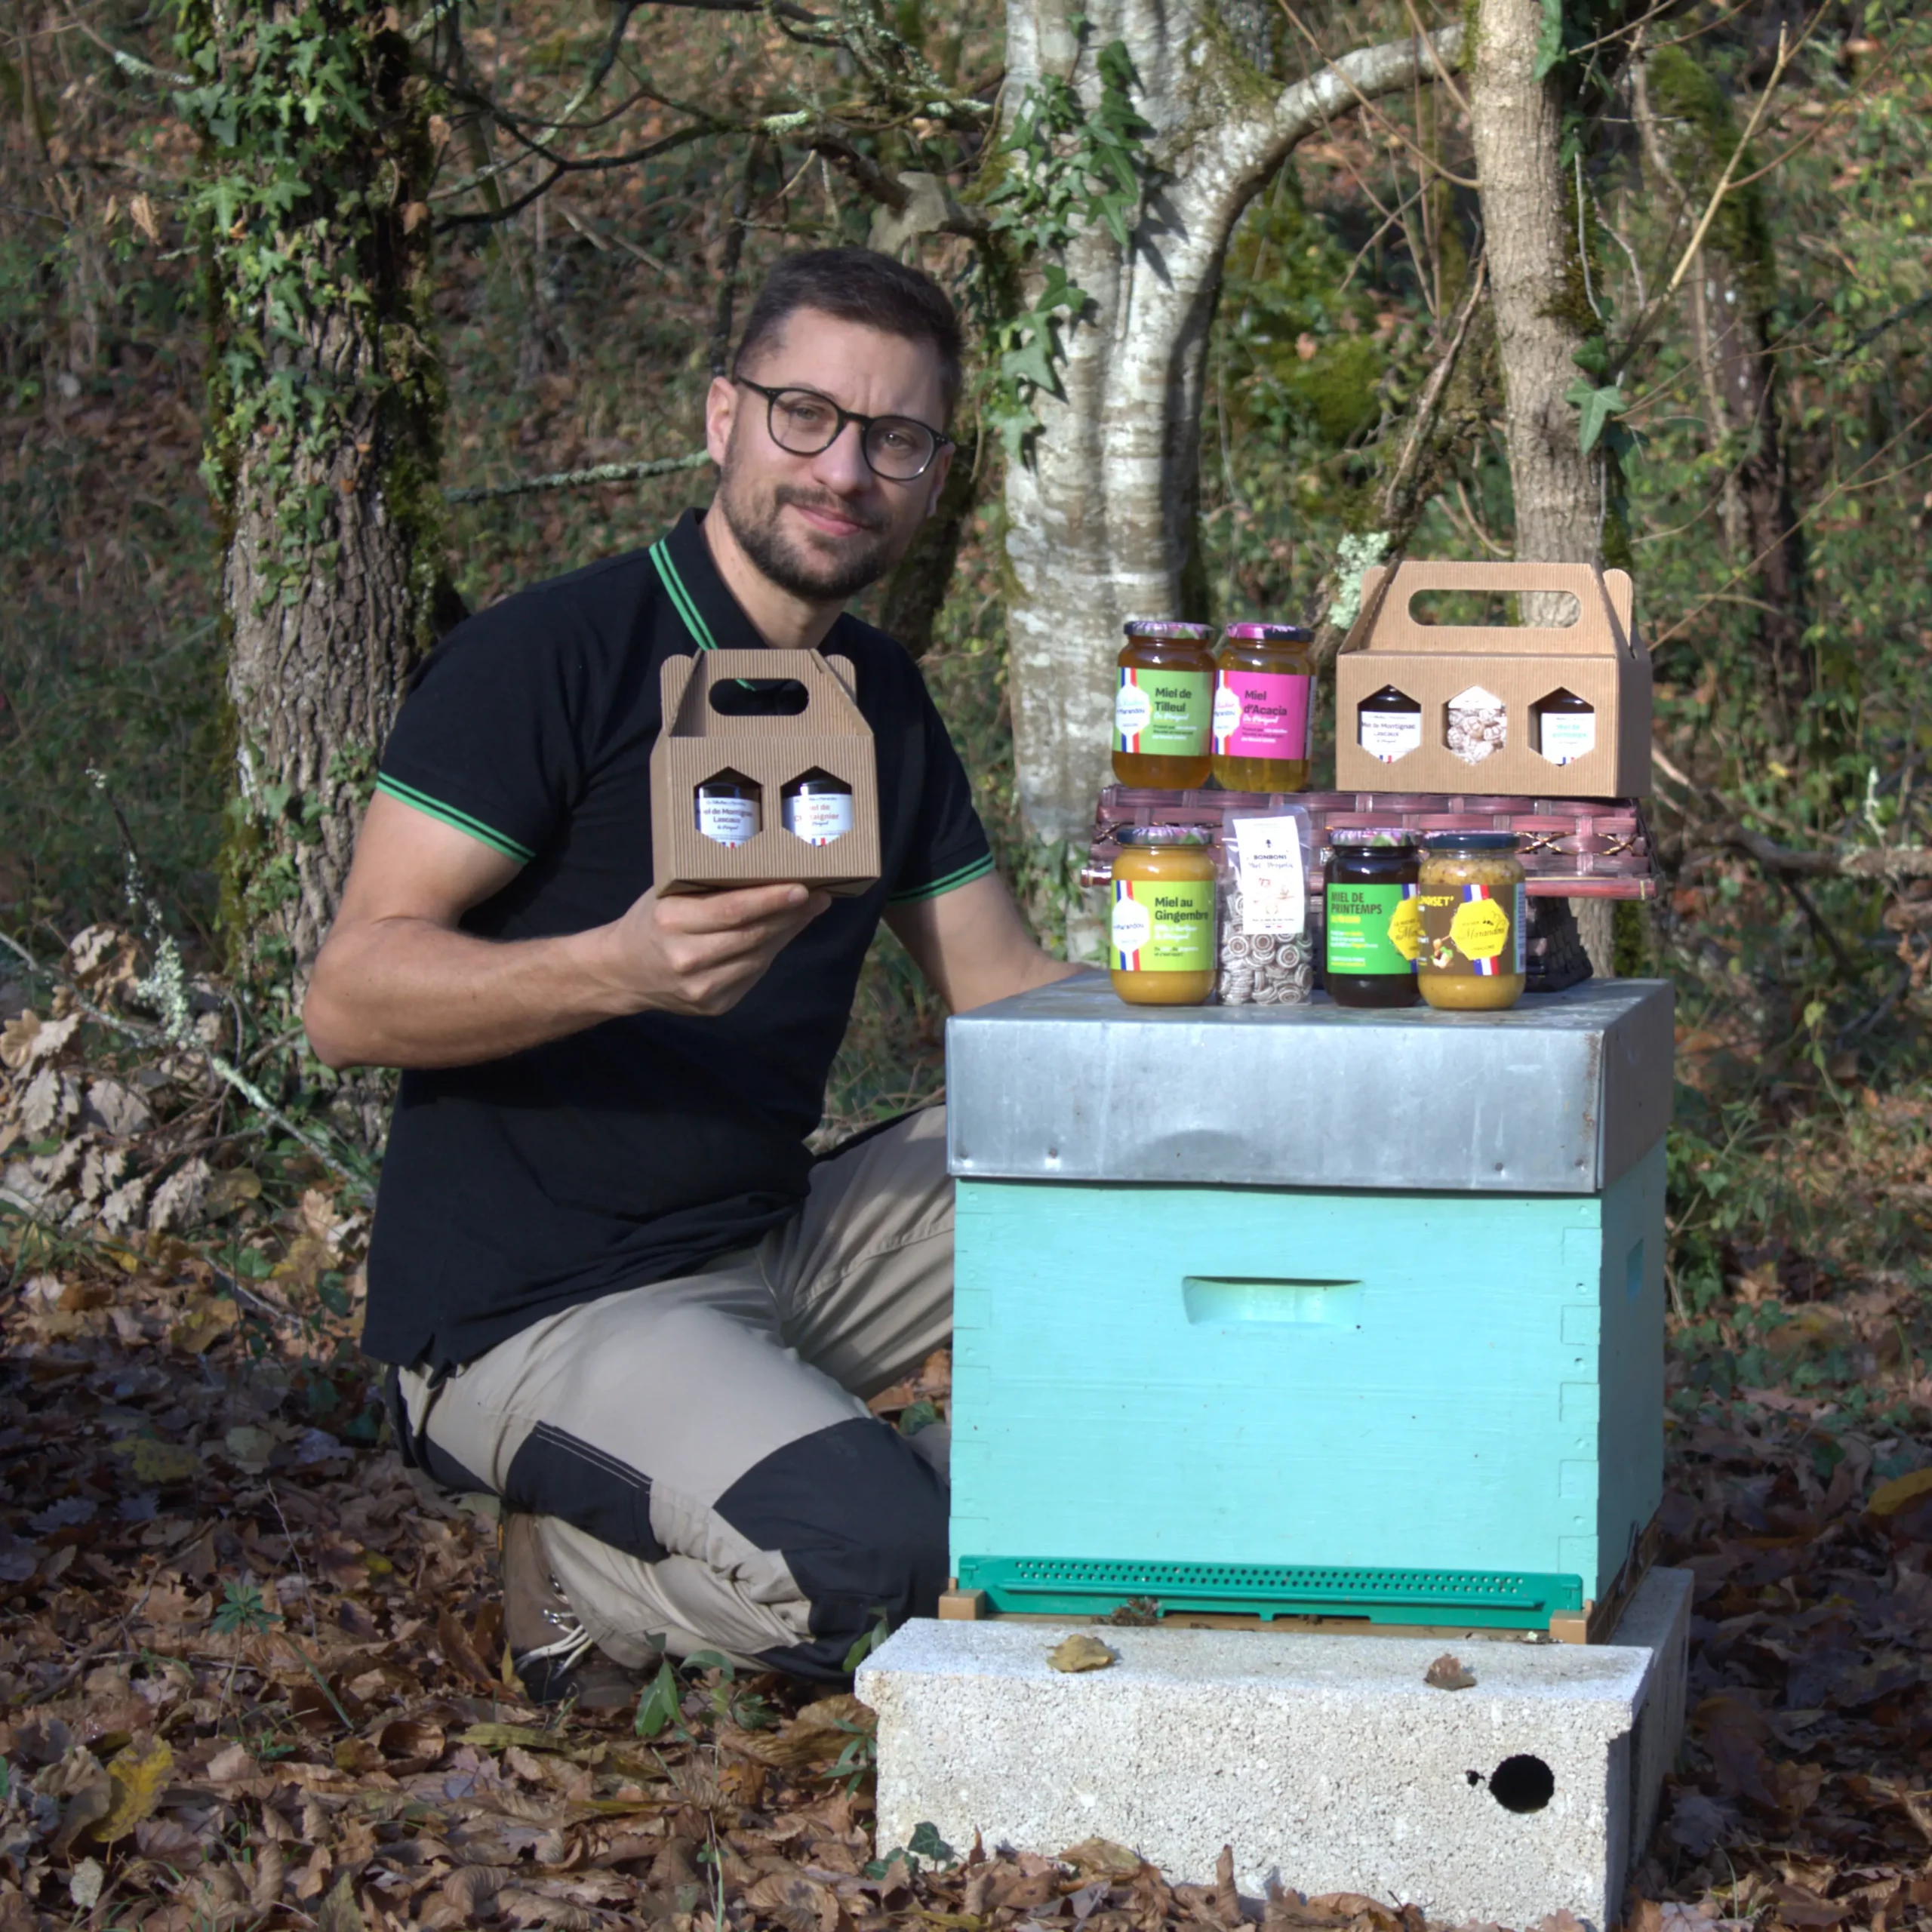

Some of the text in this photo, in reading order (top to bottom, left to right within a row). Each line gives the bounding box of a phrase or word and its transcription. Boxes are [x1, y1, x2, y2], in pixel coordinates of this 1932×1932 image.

[1155, 688, 1192, 699] Miel de
[1244, 690, 1267, 700] Miel
[1155, 701, 1186, 712] Tilleul
[1155, 897, 1193, 907] Miel au
[1331, 892, 1364, 903] MIEL DE
[1331, 903, 1383, 915] PRINTEMPS
